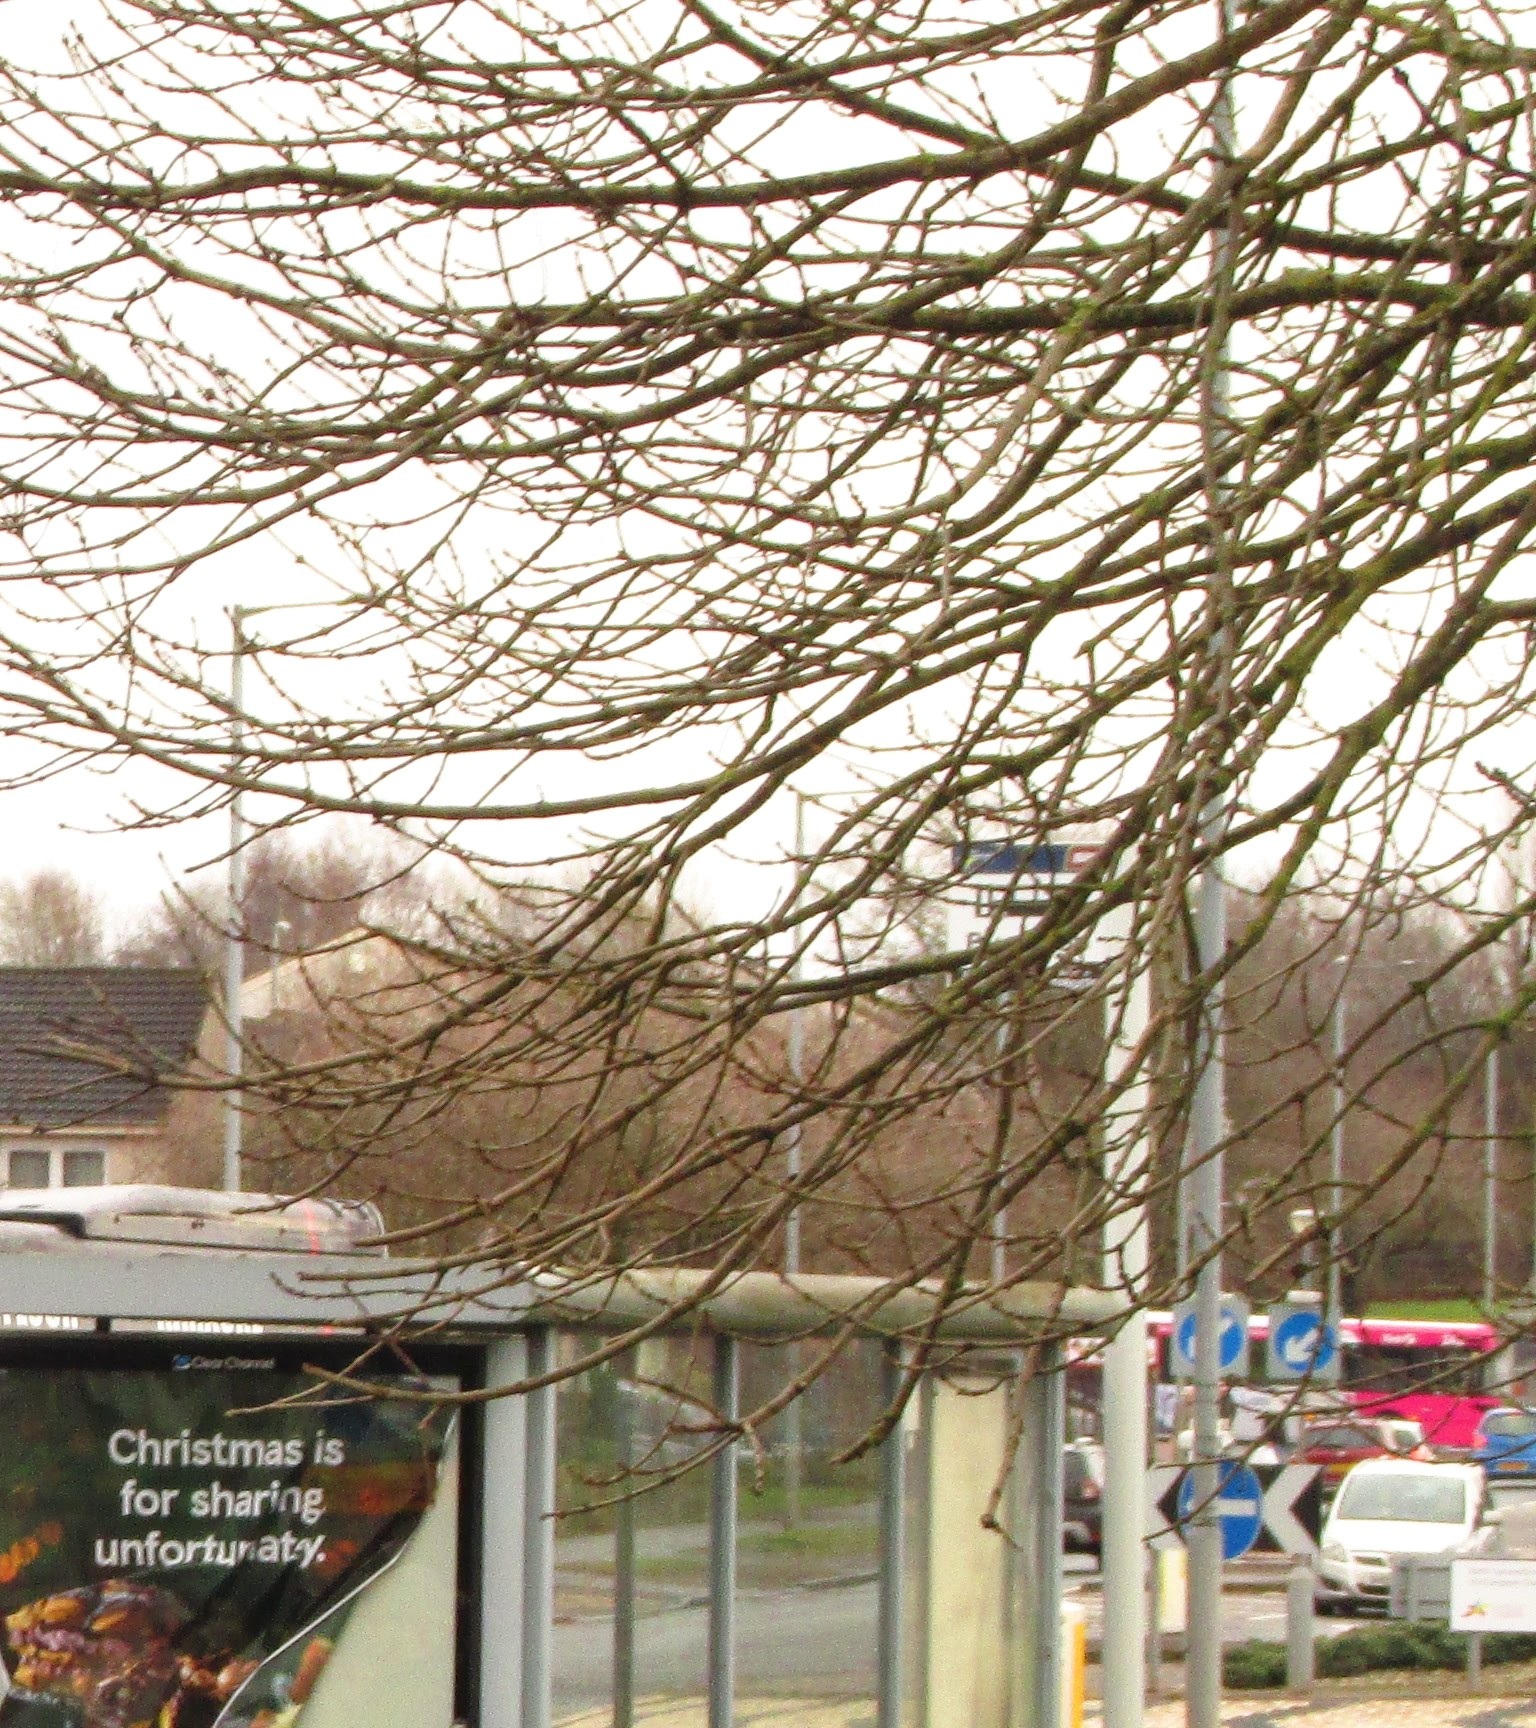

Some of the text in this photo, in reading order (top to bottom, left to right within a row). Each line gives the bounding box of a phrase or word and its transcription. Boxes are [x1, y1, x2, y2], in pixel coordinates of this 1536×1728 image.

[109, 1429, 345, 1467] Christmas is
[119, 1478, 325, 1526] for sharing
